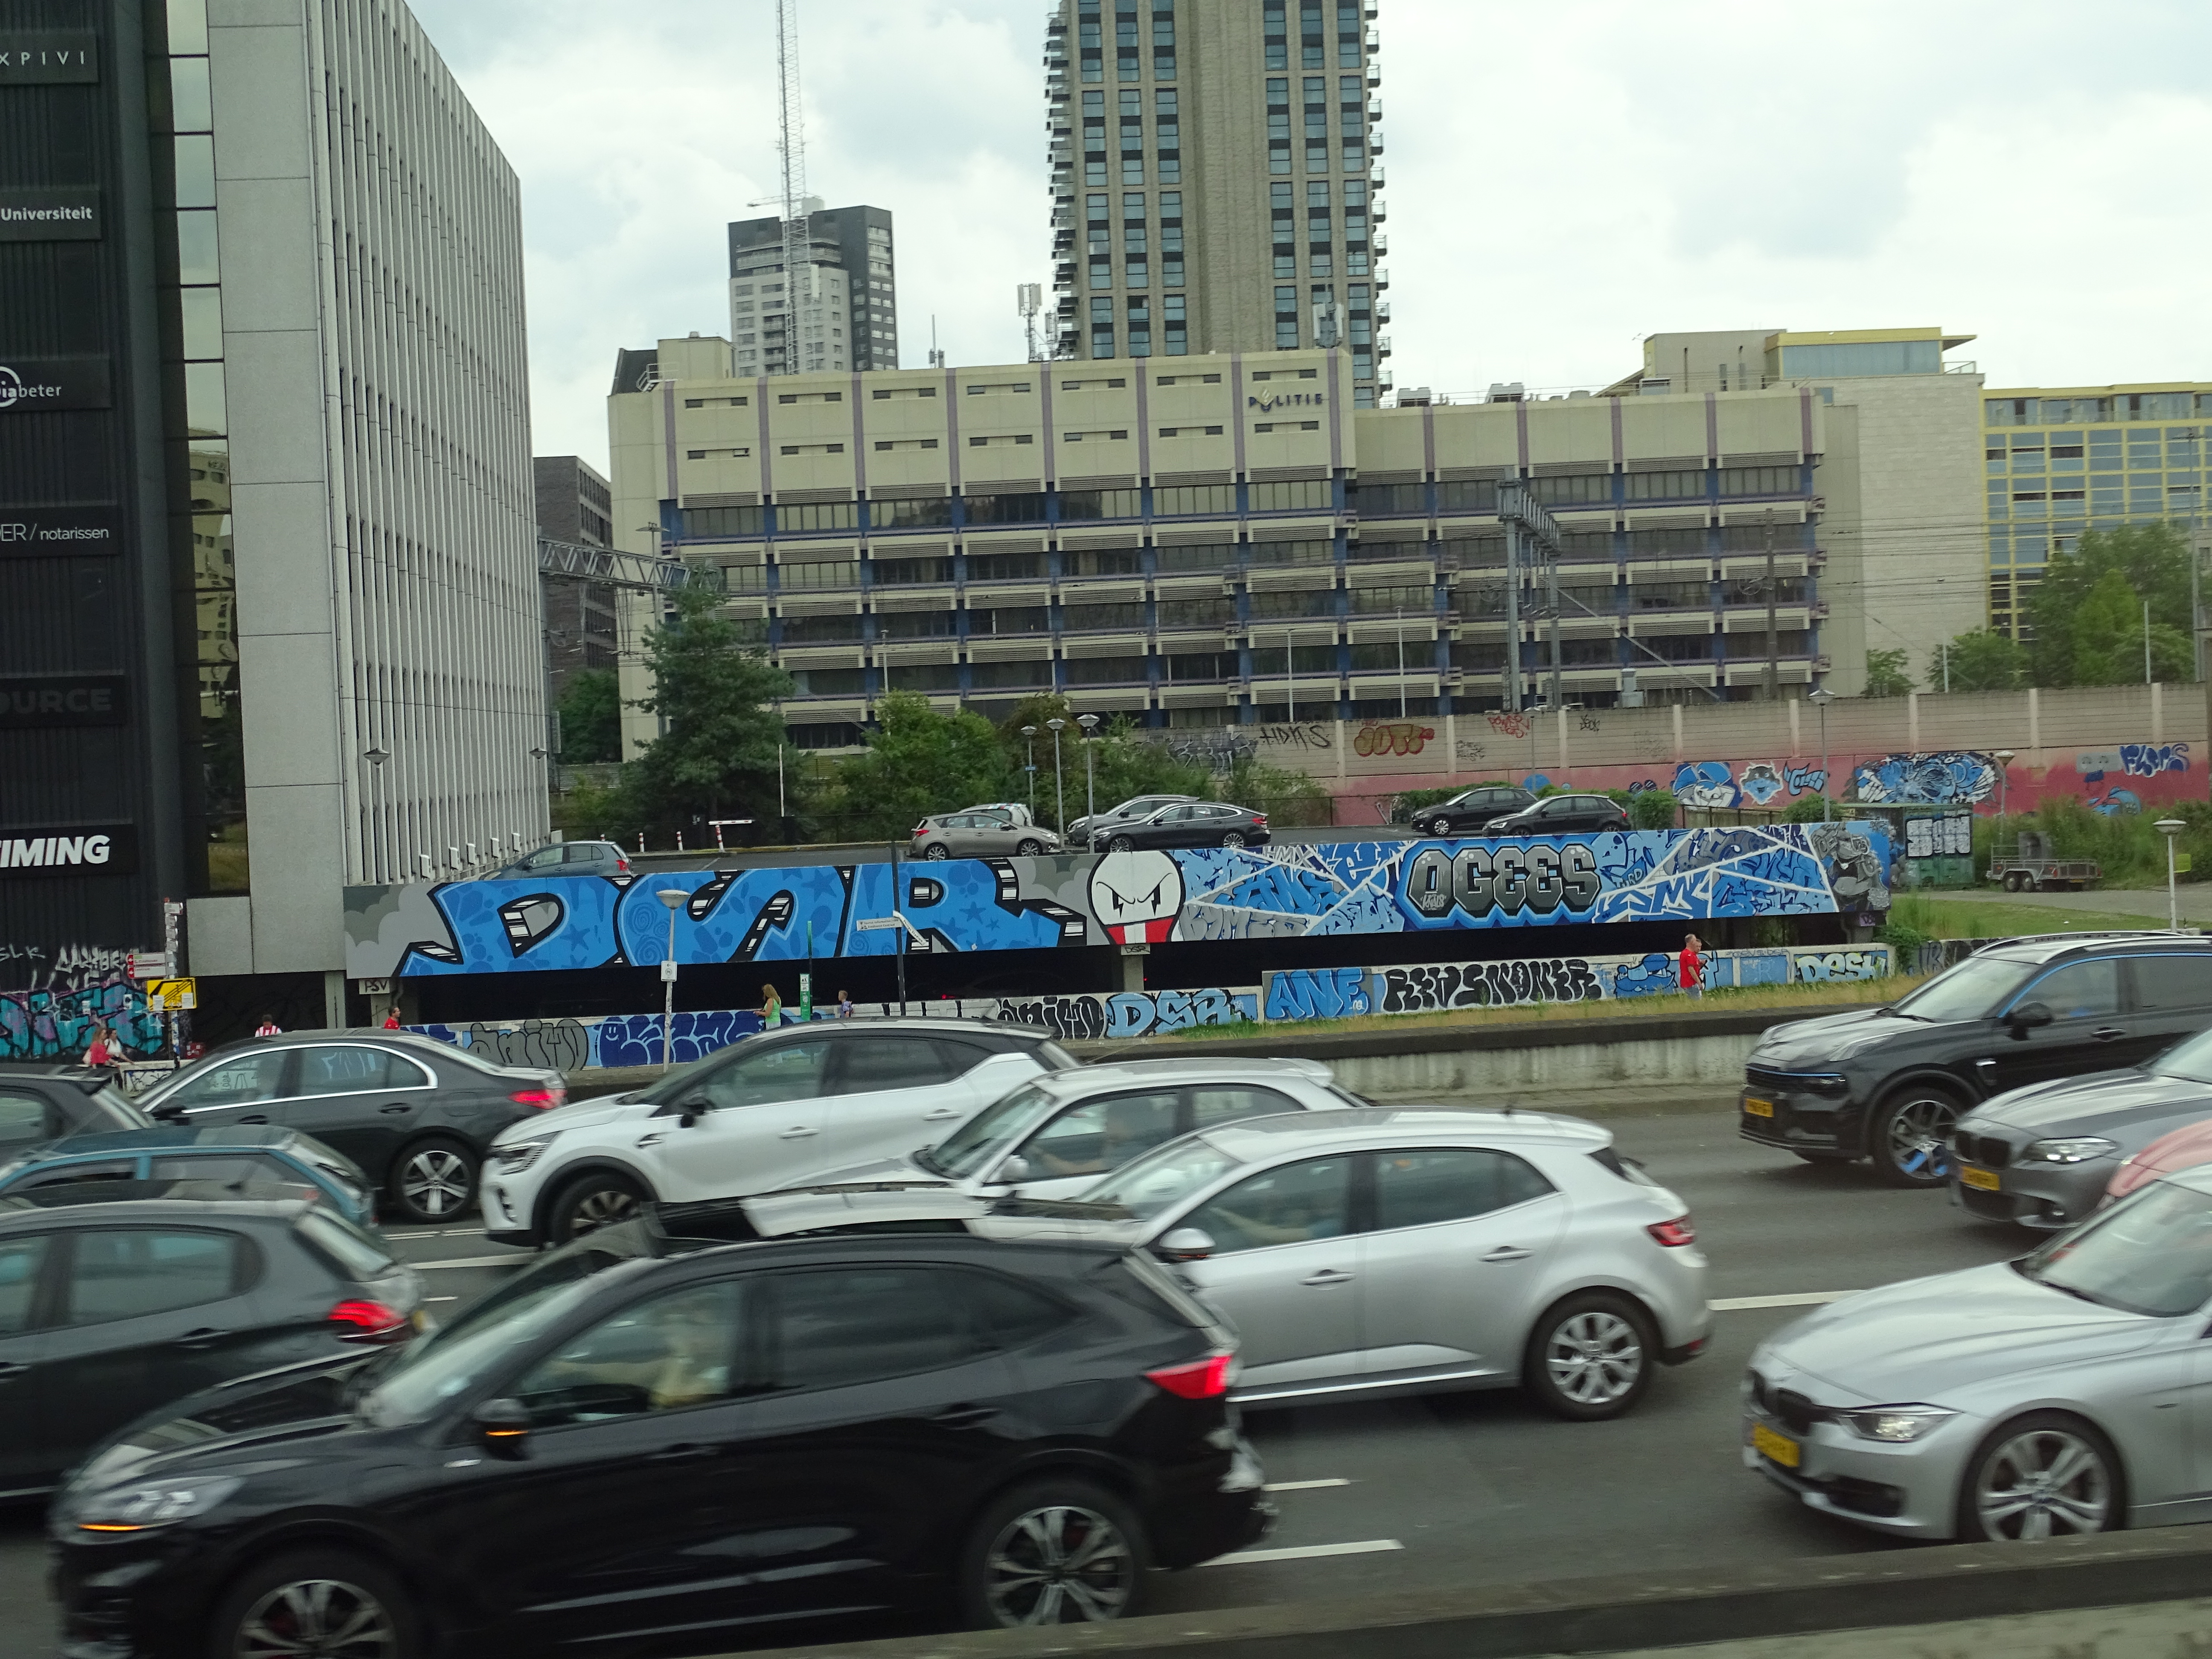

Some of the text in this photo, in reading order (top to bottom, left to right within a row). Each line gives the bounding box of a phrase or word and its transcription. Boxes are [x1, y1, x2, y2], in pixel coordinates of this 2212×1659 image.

[1, 206, 93, 221] Universiteit
[0, 382, 62, 399] iabeter
[0, 524, 26, 542] ER
[40, 525, 109, 541] notarissen
[0, 834, 110, 868] IMING
[364, 979, 388, 992] PSV
